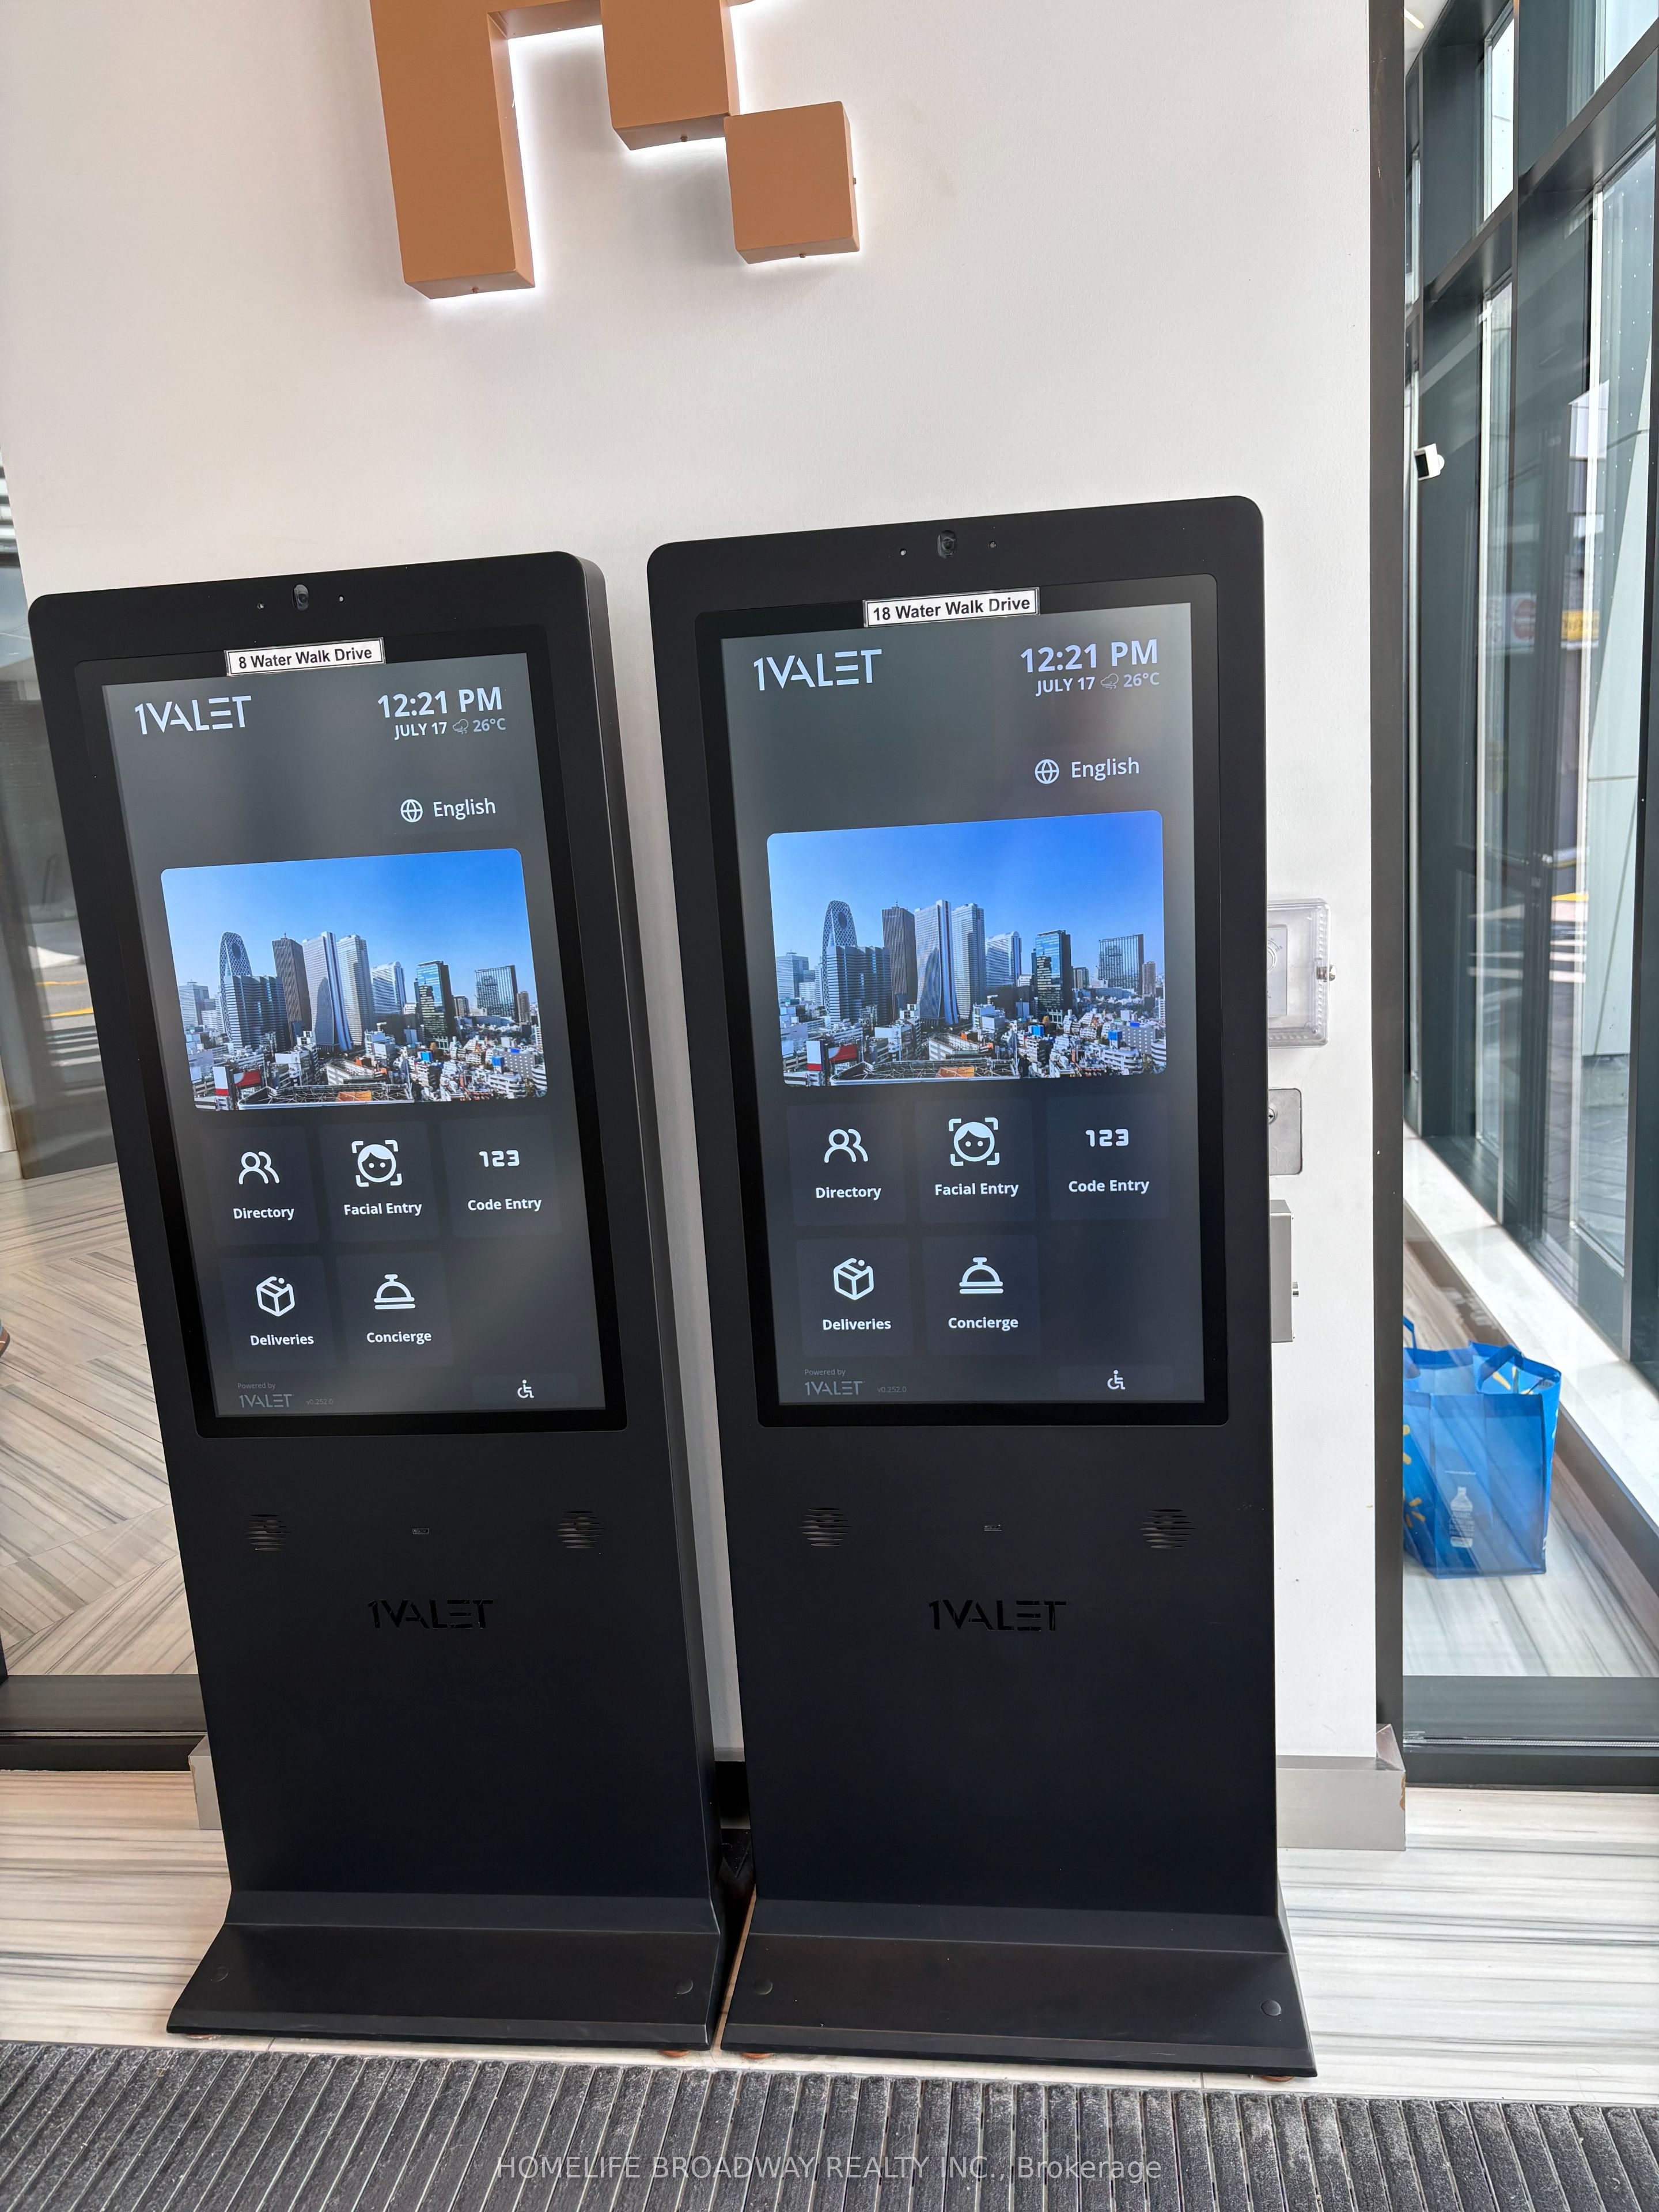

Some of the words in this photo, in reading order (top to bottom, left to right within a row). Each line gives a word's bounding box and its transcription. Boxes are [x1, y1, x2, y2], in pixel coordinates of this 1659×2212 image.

[873, 607, 891, 621] 18
[895, 604, 941, 619] Water
[945, 600, 984, 615] Walk
[989, 597, 1031, 612] Drive
[239, 656, 247, 669] 8
[251, 654, 292, 668] Water
[296, 650, 331, 664] Walk
[335, 647, 372, 661] Drive
[1020, 643, 1097, 673] 12:21
[1111, 639, 1157, 666] PM
[753, 649, 882, 691] 1VALET
[1035, 678, 1073, 696] JULY
[1077, 676, 1095, 690] 17
[1123, 672, 1160, 687] 26°C
[378, 691, 448, 718] 12:21
[459, 686, 502, 713] PM
[134, 695, 252, 736] 1VALET
[394, 723, 427, 740] JULY
[431, 722, 447, 734] 17
[472, 718, 506, 732] 26°C
[1071, 757, 1140, 781] English
[433, 798, 497, 821] English
[1085, 1128, 1129, 1147] 123
[479, 1150, 520, 1167] 123
[815, 1185, 881, 1201] Directory
[934, 1183, 976, 1196] Facial
[980, 1182, 1019, 1198] Entry
[1068, 1180, 1105, 1193] Code
[1109, 1179, 1150, 1194] Entry
[344, 1202, 382, 1216] Facial
[386, 1202, 422, 1216] Entry
[467, 1198, 501, 1211] Code
[506, 1197, 542, 1211] Entry
[233, 1206, 294, 1221] Directory
[822, 1318, 892, 1331] Deliveries
[948, 1316, 1019, 1331] Concierge
[249, 1333, 315, 1346] Deliveries
[366, 1331, 432, 1344] Concierge
[837, 1369, 846, 1377] by
[805, 1381, 863, 1396] 1VALET
[239, 1393, 293, 1408] 1VALET
[366, 1599, 494, 1630] 1VALET
[928, 1599, 1067, 1631] 1VALET
